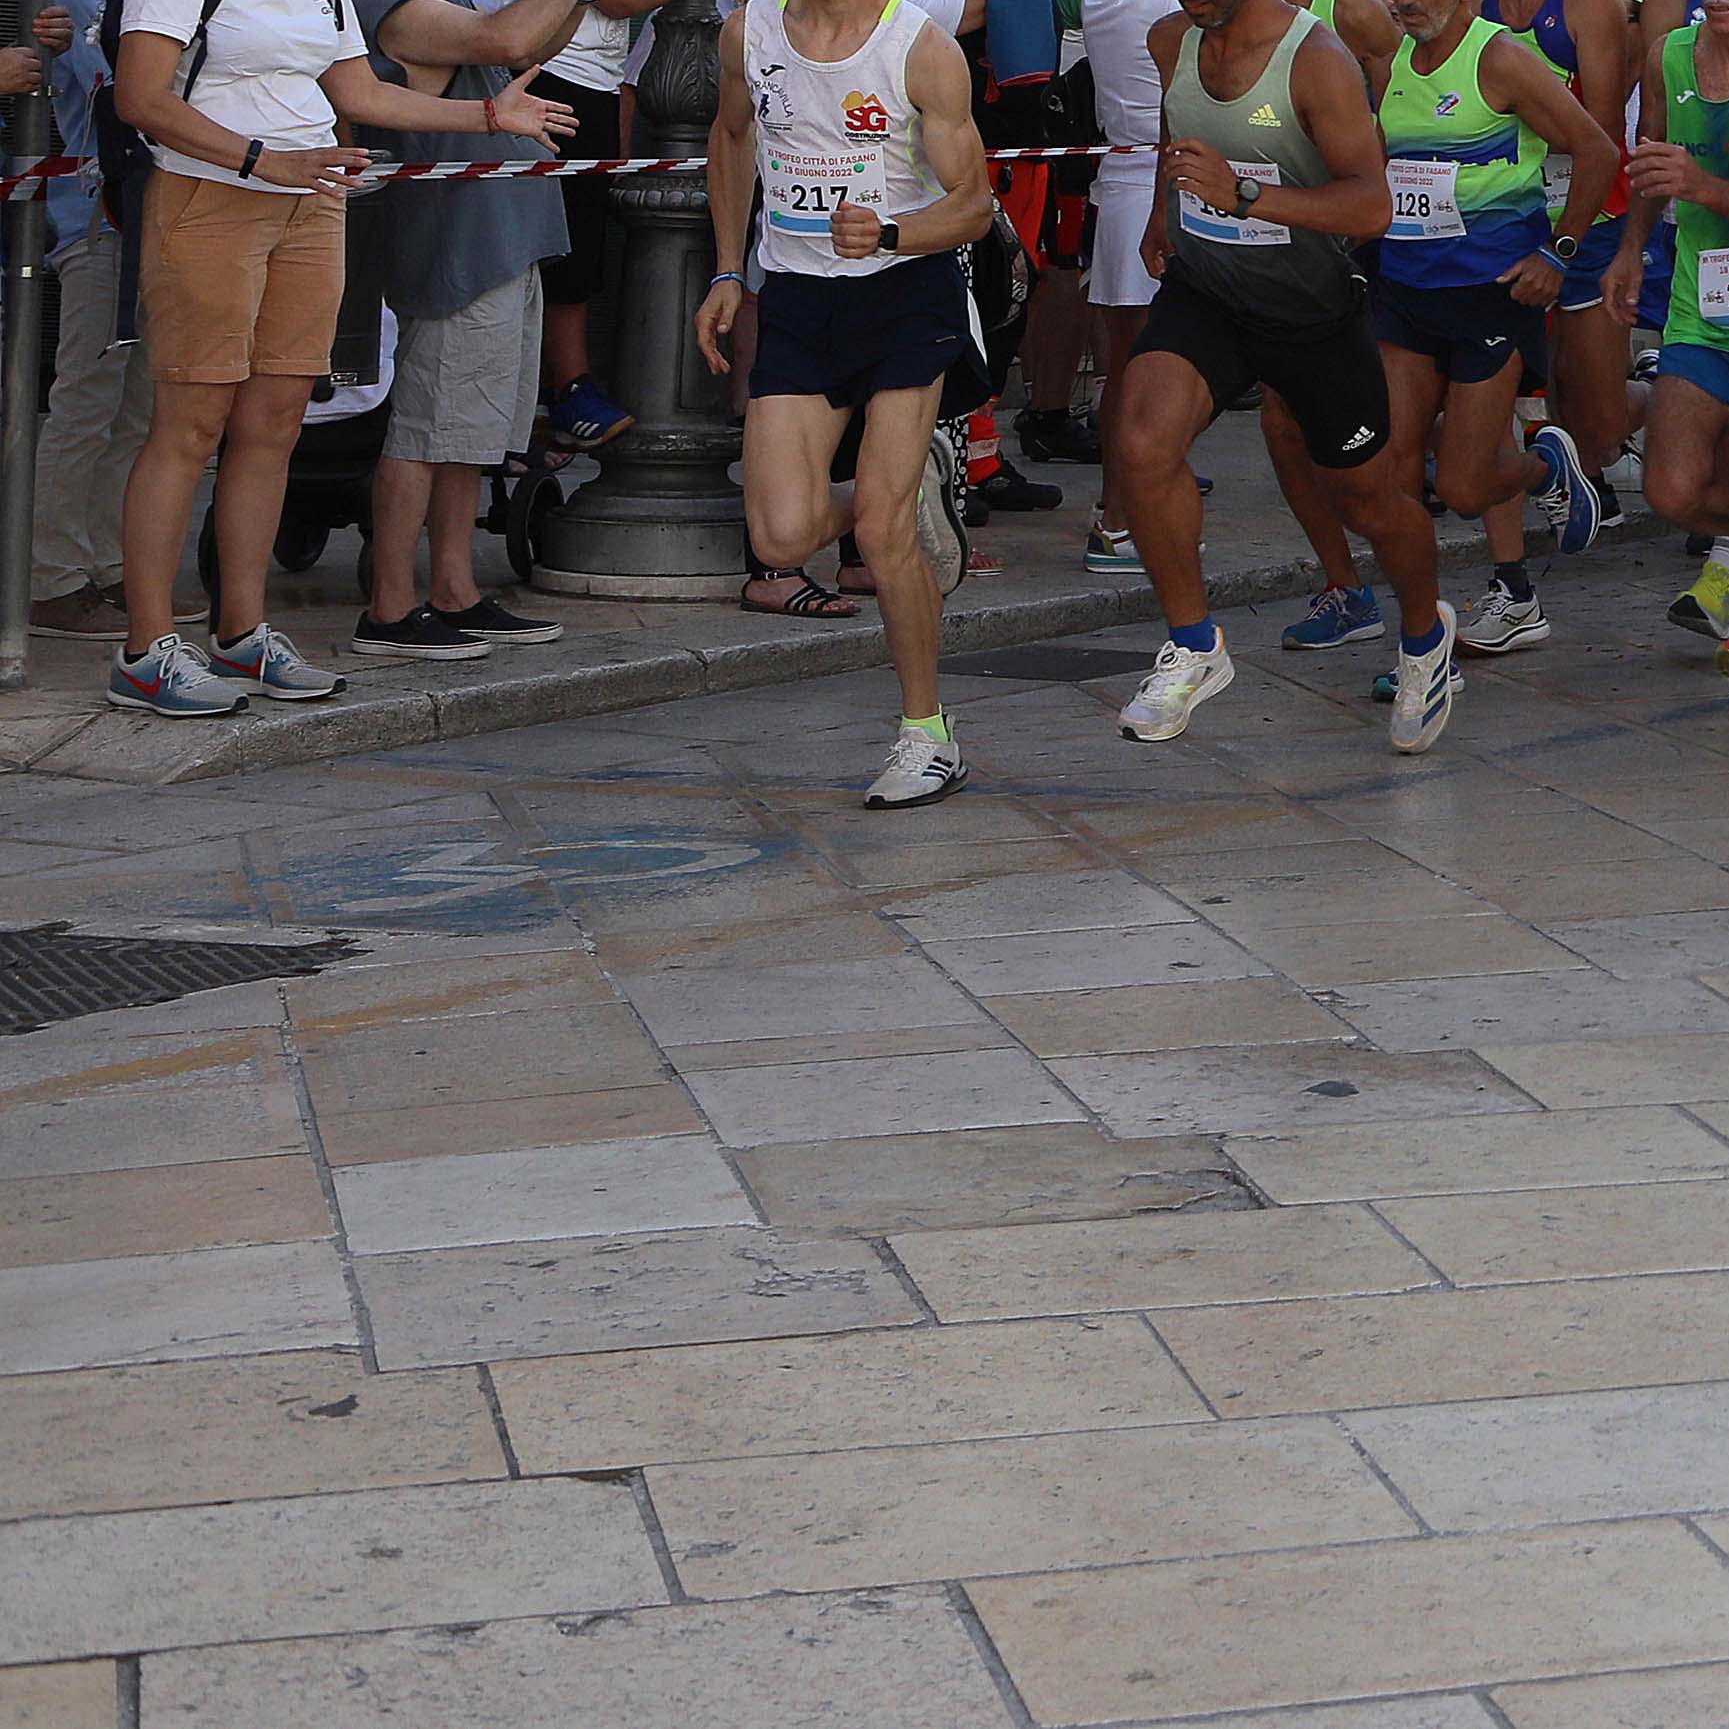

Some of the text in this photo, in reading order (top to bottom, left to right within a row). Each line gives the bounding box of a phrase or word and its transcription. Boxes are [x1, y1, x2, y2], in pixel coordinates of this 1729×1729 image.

[845, 105, 888, 132] SG
[1248, 117, 1282, 128] adidas
[774, 149, 801, 164] TROFEO
[803, 156, 826, 166] CITTÀ
[829, 156, 838, 166] DI
[840, 153, 876, 164] FASANO
[795, 168, 827, 177] GIUGNO
[830, 167, 853, 177] 2022
[791, 183, 849, 212] 217
[1395, 191, 1431, 218] 128
[1342, 431, 1375, 451] adidas
